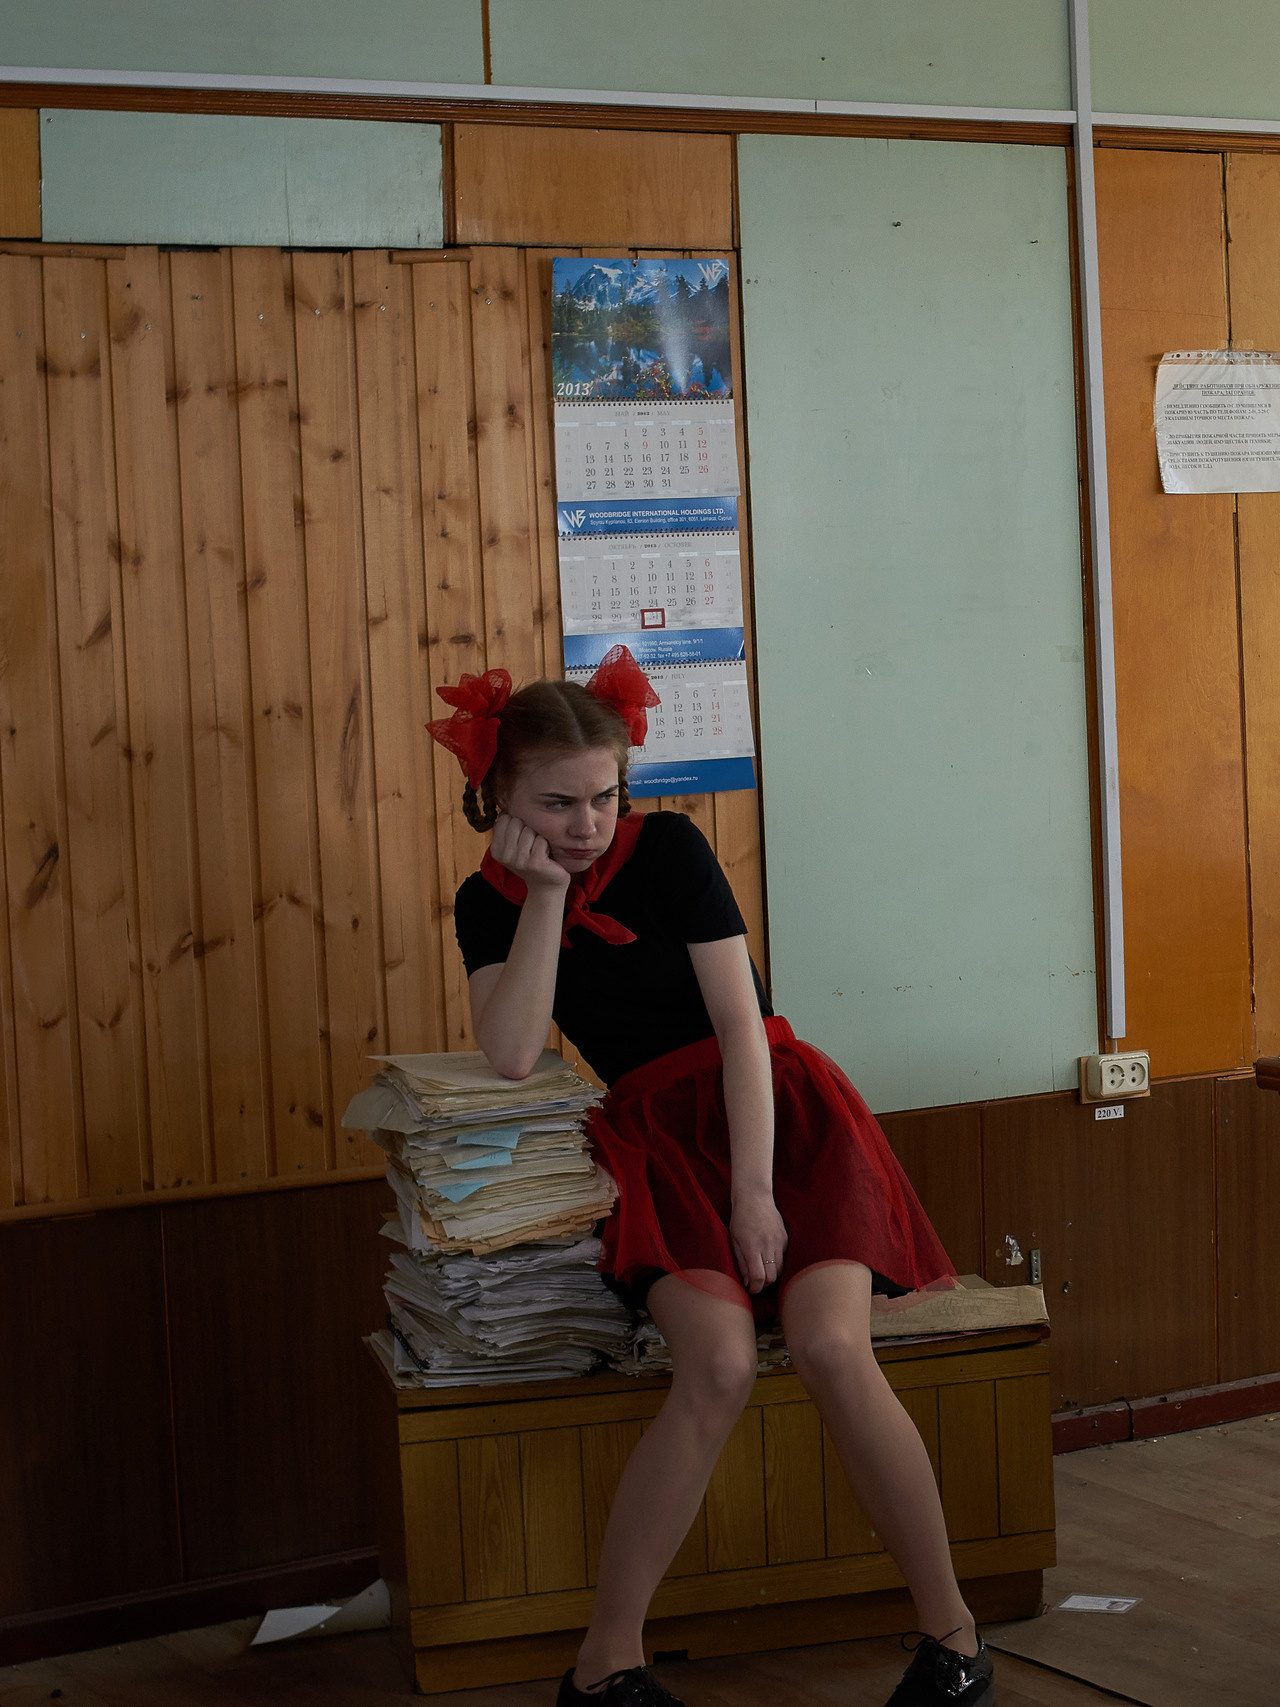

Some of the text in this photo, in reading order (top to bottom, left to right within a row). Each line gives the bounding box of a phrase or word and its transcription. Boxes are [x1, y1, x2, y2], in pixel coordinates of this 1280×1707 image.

[556, 382, 590, 395] 2013
[624, 427, 704, 437] 1 2 3 4 5
[586, 440, 707, 451] 6 7 8 9 10 11 12
[585, 452, 708, 464] 13 14 15 16 17 18 19
[585, 465, 709, 477] 20 21 22 23 24 25 26
[586, 479, 671, 490] 27 28 29 30 31
[589, 510, 631, 518] WOODBRIDGE
[632, 509, 680, 517] INTERNATIONAL
[681, 508, 712, 516] HOLDINGS
[718, 514, 733, 522] Cyprus
[611, 558, 710, 570] 1 2 3 4 5 6
[593, 570, 713, 584] 7 8 9 10 11 12 13
[592, 584, 714, 597] 14 15 16 17 18 19 20
[591, 596, 714, 610] 21 22 23 24 25 26 27
[592, 614, 602, 623] 28
[611, 613, 622, 622] 29
[630, 612, 640, 621] 30
[674, 688, 717, 700] 5 6 7
[655, 701, 720, 713] 11 12 13 14
[655, 714, 721, 726] 18 19 20 21
[655, 727, 723, 739] 25 26 27 28
[1097, 1107, 1122, 1118] 220 V.
